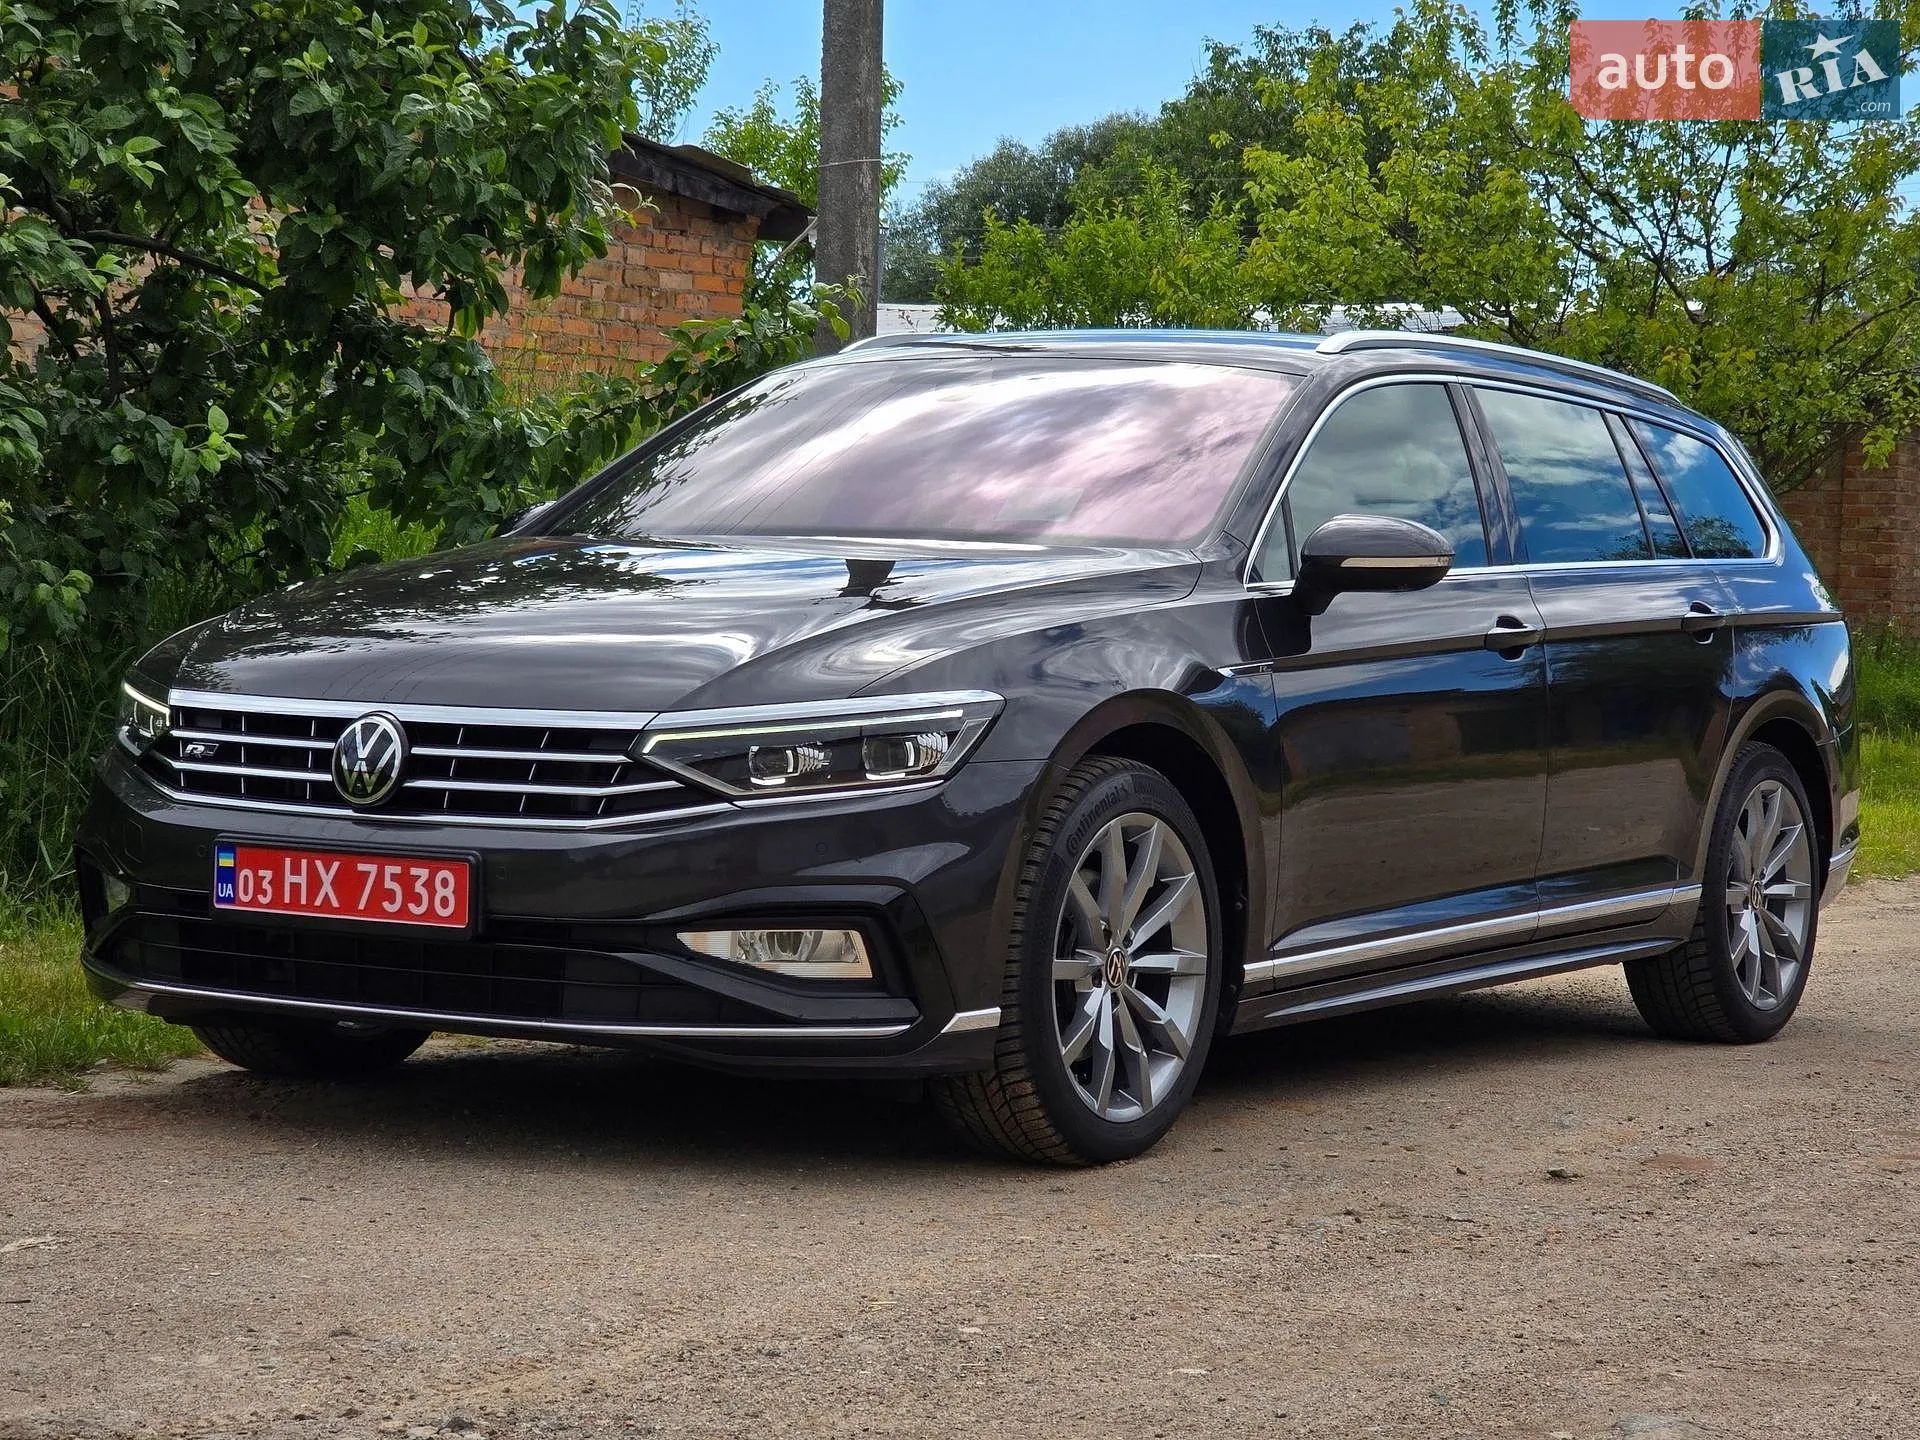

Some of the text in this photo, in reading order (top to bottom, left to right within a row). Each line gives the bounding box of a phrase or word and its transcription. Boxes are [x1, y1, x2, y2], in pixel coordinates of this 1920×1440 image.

[1066, 786, 1122, 857] Continental
[218, 882, 234, 899] UA
[238, 857, 456, 917] 03 HX 7538
